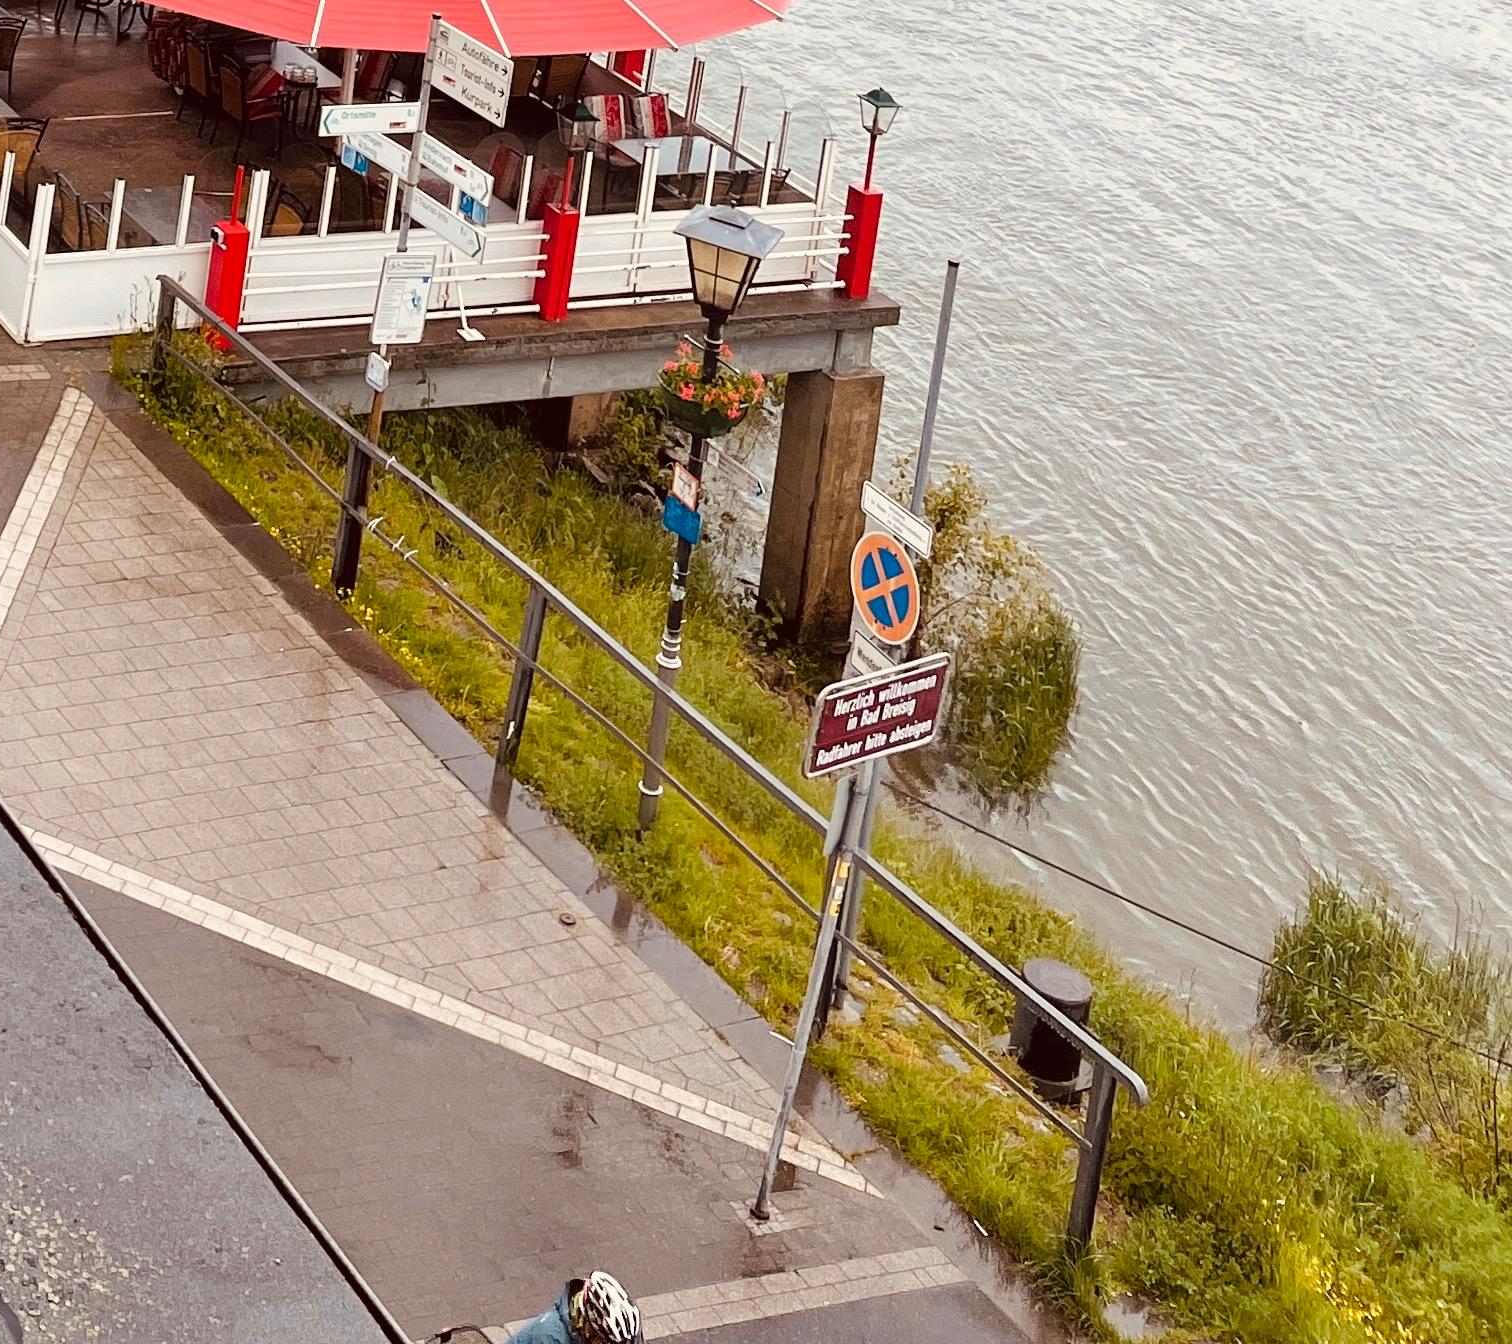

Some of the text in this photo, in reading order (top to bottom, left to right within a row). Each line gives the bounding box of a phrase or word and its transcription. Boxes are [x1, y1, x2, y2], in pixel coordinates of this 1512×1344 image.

[461, 85, 493, 113] Kurpark
[833, 674, 937, 717] Herzlich willkommen
[846, 696, 916, 731] in Bad Breisig
[816, 719, 932, 766] Radfahrer bitte absteigen
